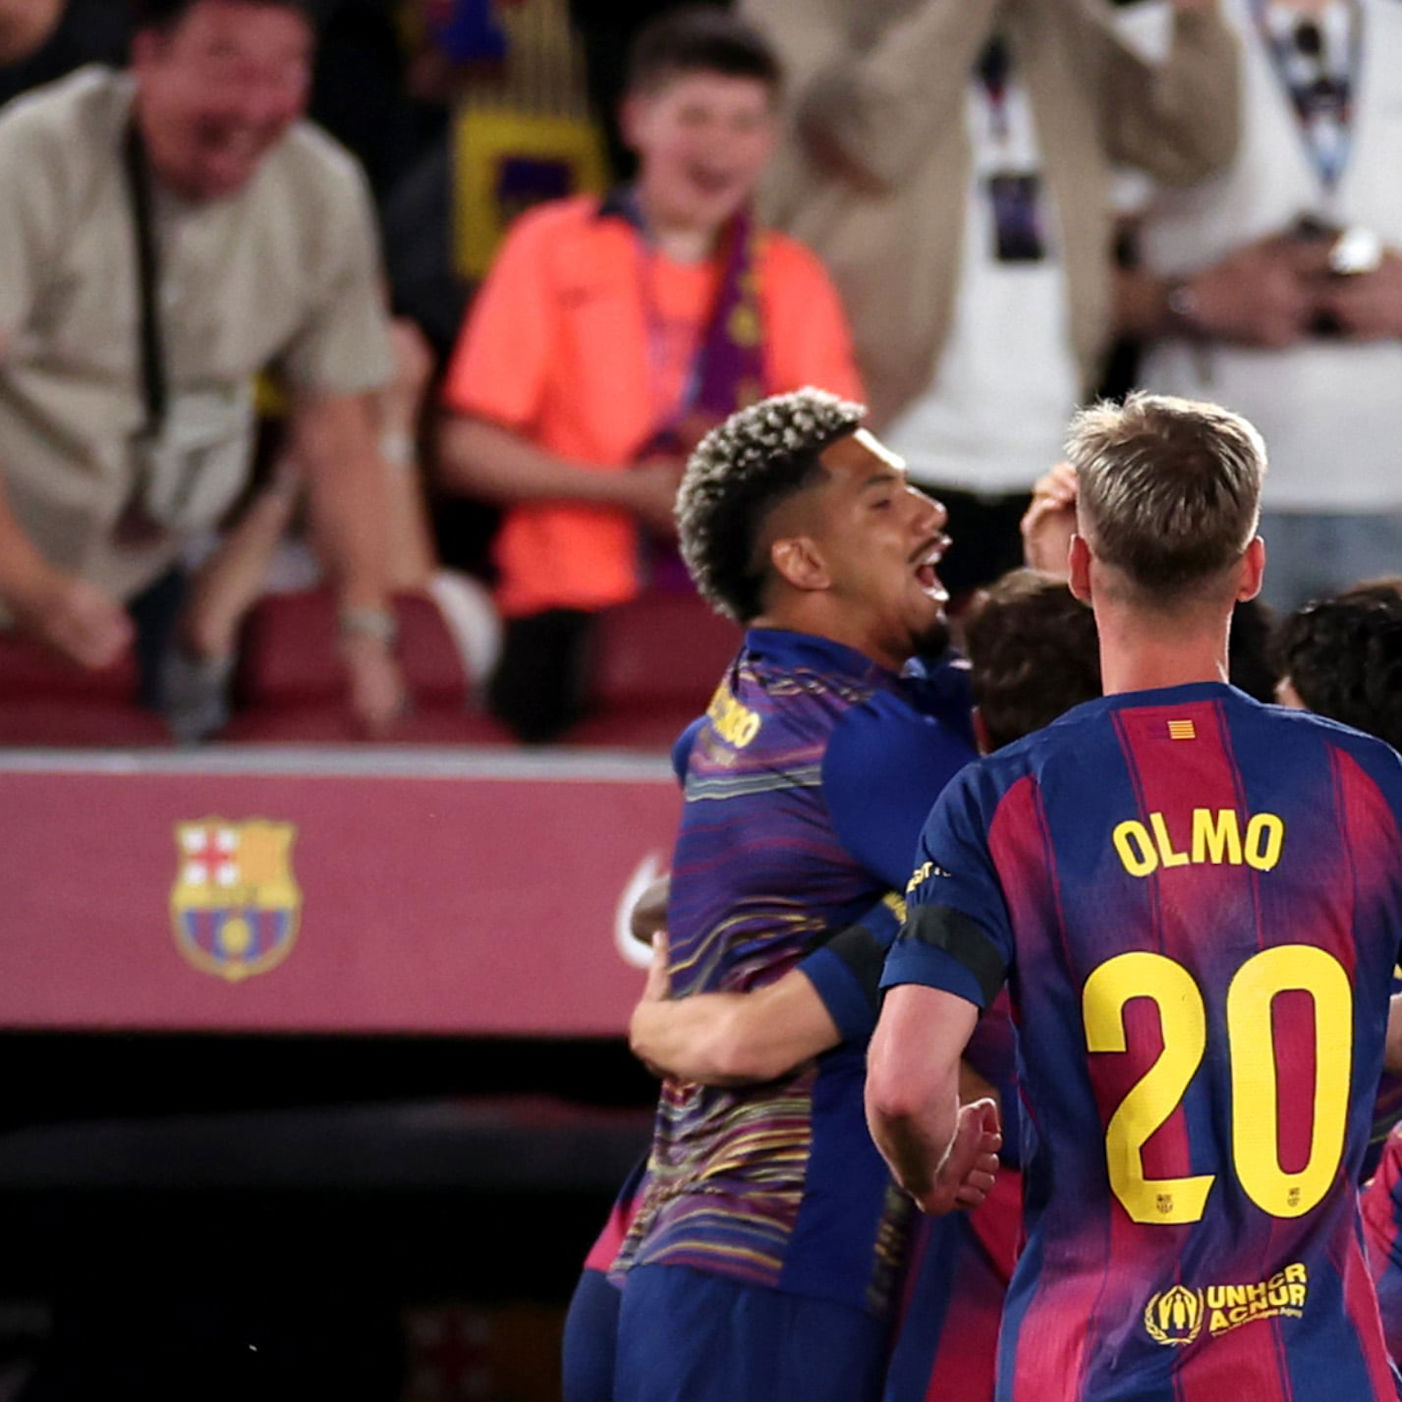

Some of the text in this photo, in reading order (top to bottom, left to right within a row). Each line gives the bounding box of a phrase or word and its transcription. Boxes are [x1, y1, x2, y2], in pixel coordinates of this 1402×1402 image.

[1112, 807, 1285, 878] OLMO
[1082, 943, 1354, 1225] 20
[1206, 1262, 1308, 1309] UNHCR
[1209, 1283, 1307, 1333] ACNUR
